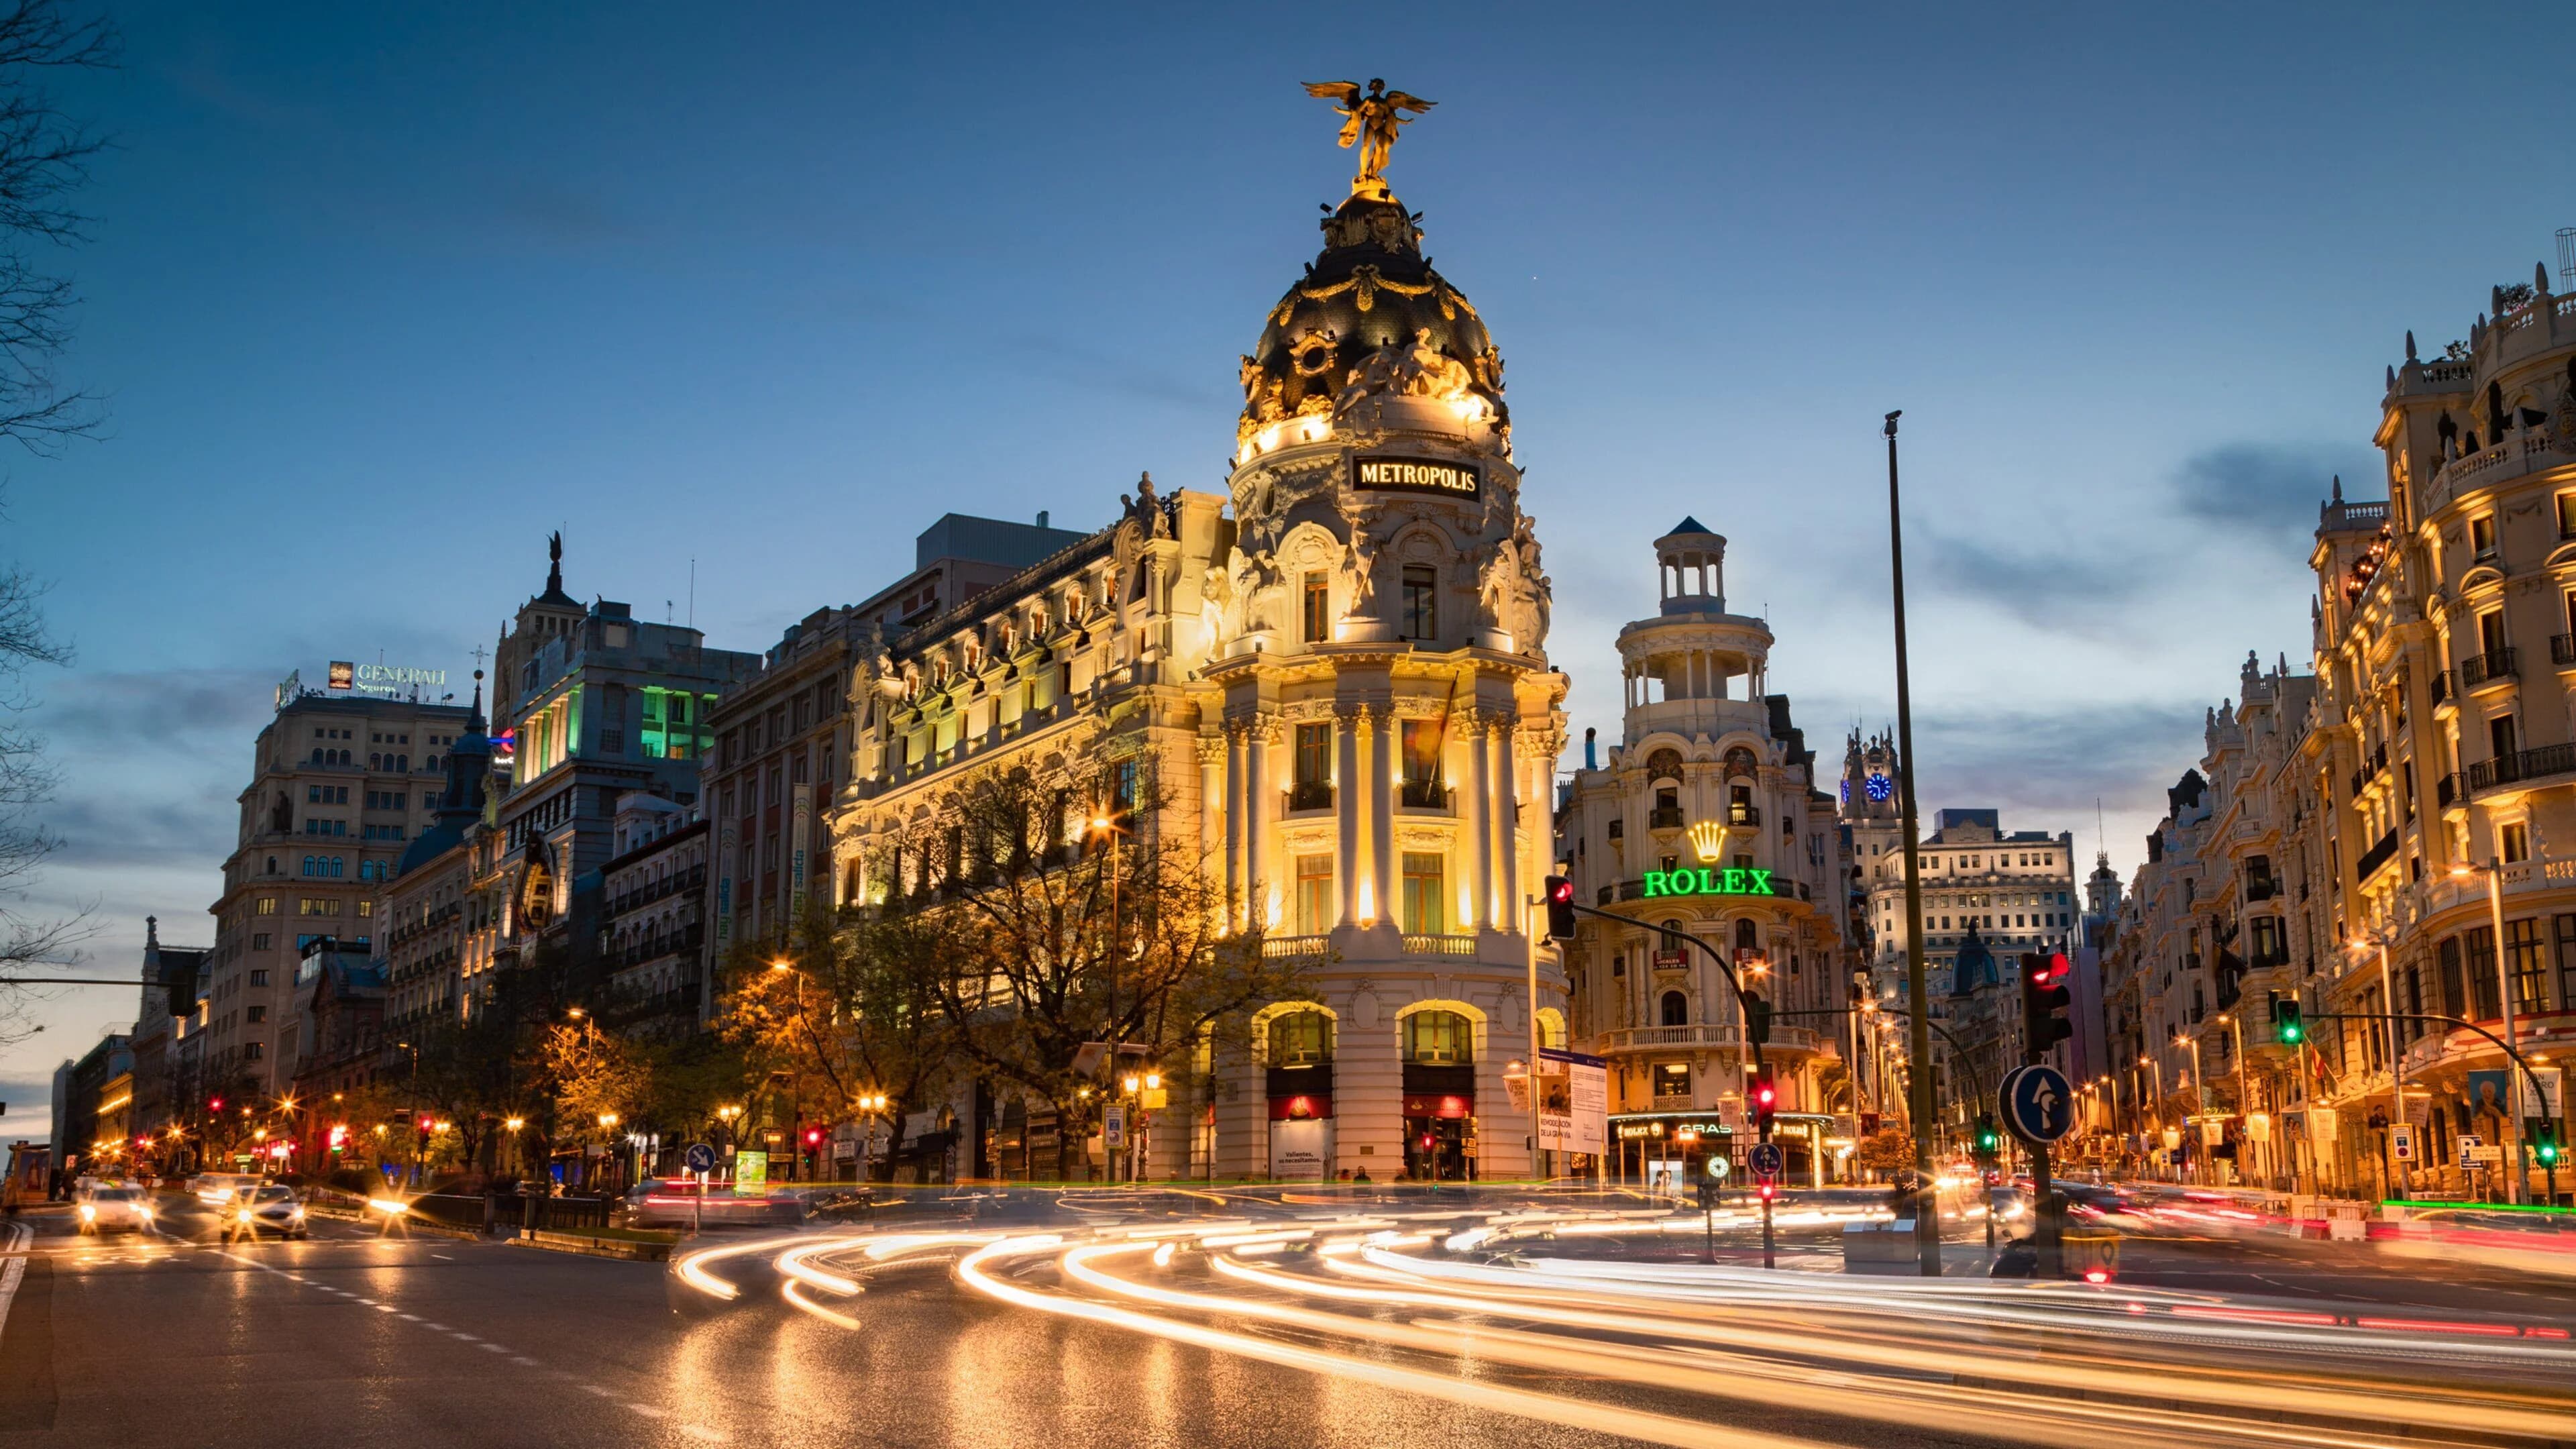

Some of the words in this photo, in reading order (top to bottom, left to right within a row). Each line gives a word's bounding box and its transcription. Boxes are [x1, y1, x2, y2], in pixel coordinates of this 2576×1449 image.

[1361, 464, 1476, 492] METROPOLIS
[356, 680, 396, 693] Seguros
[358, 663, 446, 686] GENERALI
[792, 849, 804, 889] salida
[1644, 868, 1774, 896] ROLEX
[719, 877, 731, 914] salida
